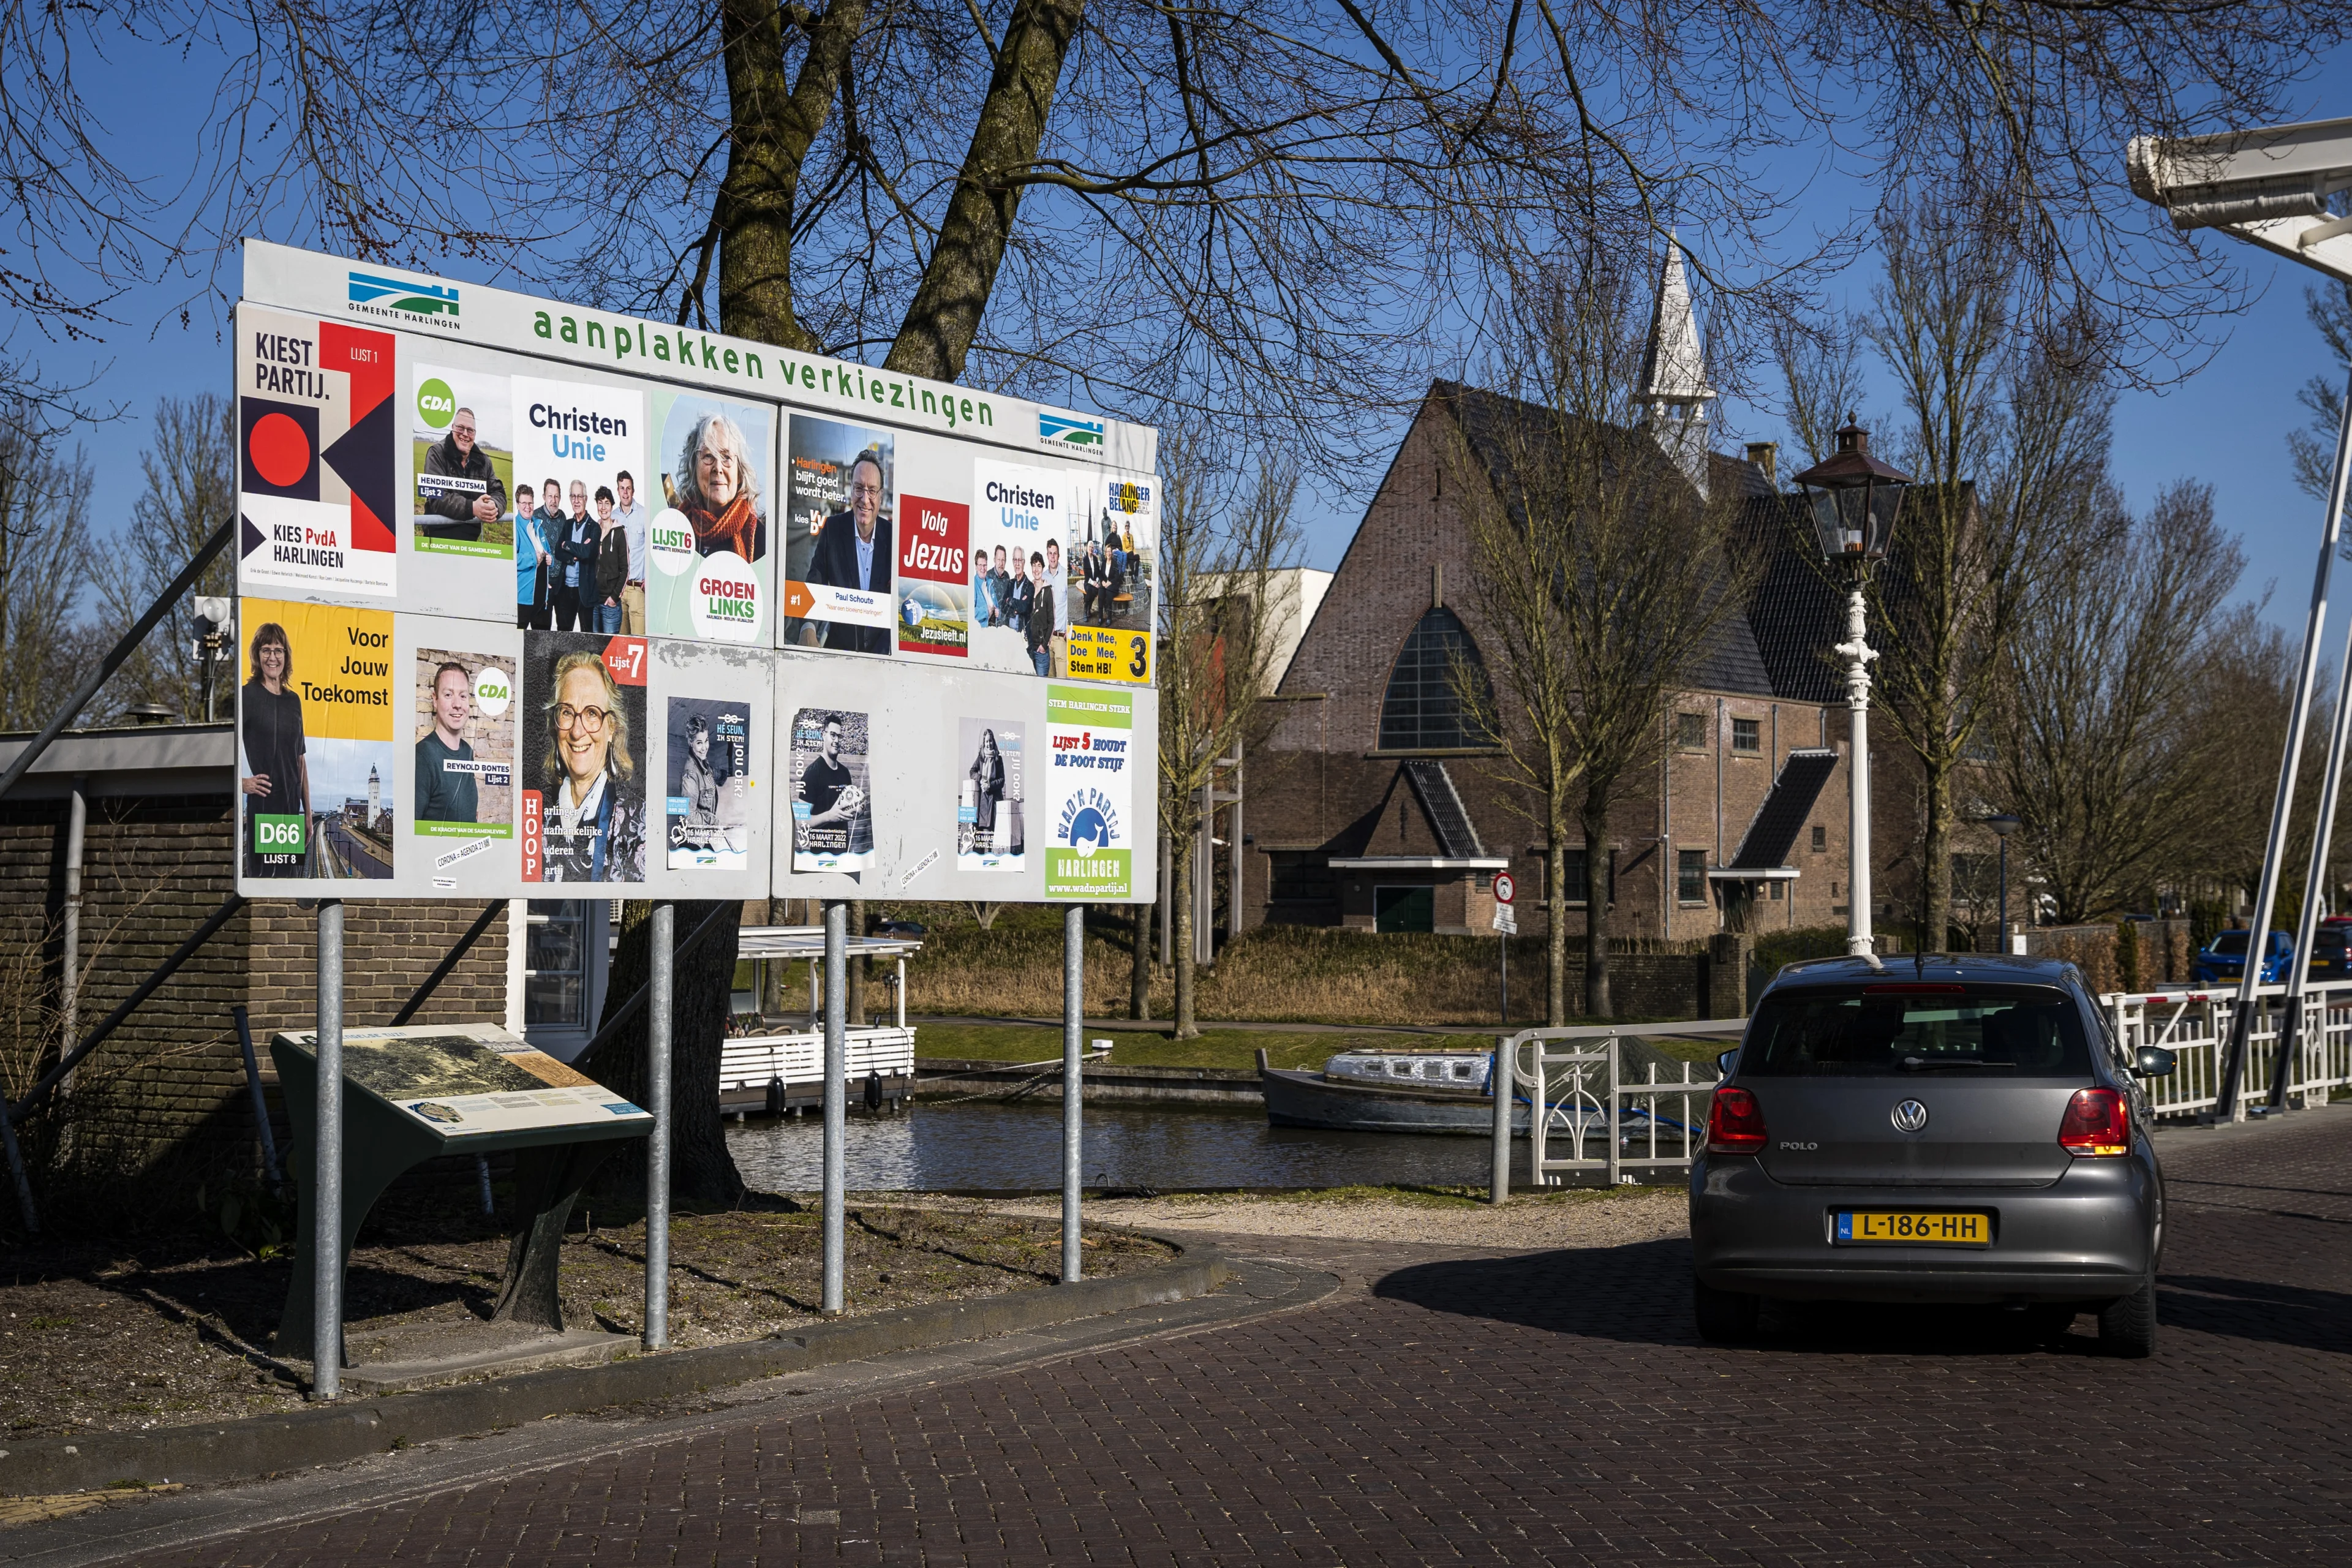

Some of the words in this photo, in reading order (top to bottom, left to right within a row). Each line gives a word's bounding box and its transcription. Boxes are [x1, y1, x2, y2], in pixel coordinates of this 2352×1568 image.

[349, 303, 399, 318] GEMEENTE
[404, 313, 460, 330] HARLINGEN
[256, 331, 313, 367] KIEST
[350, 347, 372, 363] LIJST
[374, 351, 378, 363] 1
[533, 311, 763, 379] aanplakken
[779, 359, 993, 428] verkiezingen
[256, 363, 330, 400] PARTIJ.
[421, 395, 452, 413] CDA
[529, 403, 627, 437] Christen
[552, 434, 606, 462] Unie
[1040, 437, 1069, 449] GEMEENTE
[1071, 444, 1103, 456] HARLINGEN
[796, 456, 837, 475] Harlingen
[421, 477, 453, 487] HENDRIK
[455, 481, 485, 491] SIJTSMA
[796, 470, 815, 484] blijft
[816, 477, 839, 488] goed
[420, 488, 436, 497] Lijst
[796, 486, 821, 498] wordt
[822, 488, 846, 502] beter.
[986, 481, 1054, 510] Christen
[1109, 482, 1150, 501] HARLINGER
[1109, 497, 1137, 513] BELANG
[794, 513, 809, 524] kies
[810, 509, 827, 536] VVD
[921, 510, 948, 537] Volg
[1001, 507, 1039, 531] Unie
[274, 524, 302, 544] KIES
[306, 528, 337, 547] PvdA
[274, 545, 344, 568] HARLINGEN
[904, 535, 964, 574] Jezus
[699, 578, 755, 600] GROEN
[835, 592, 848, 601] Paul
[850, 594, 874, 605] Schoute
[709, 597, 755, 618] LINKS
[790, 594, 801, 606] #1
[347, 627, 388, 648] Voor
[921, 626, 966, 643] Jezusleeft.nl
[1071, 630, 1093, 642] Denk
[1097, 632, 1117, 646] Mee,
[609, 656, 630, 671] Lijst
[628, 644, 644, 678] 7
[1071, 644, 1087, 656] Doe
[1097, 647, 1117, 661] Mee,
[1129, 636, 1147, 678] 3
[341, 656, 388, 677] Jouw
[1071, 660, 1093, 673] Stem
[1096, 662, 1112, 674] HB!
[301, 682, 388, 706] Toekomst
[478, 684, 507, 699] CDA
[1048, 699, 1067, 708] STEM
[1068, 700, 1108, 712] HARLINGEN
[1109, 704, 1131, 714] STERK
[717, 722, 725, 734] HÉ
[726, 724, 745, 736] SEUN,
[1053, 736, 1080, 752] LIJST
[1082, 732, 1090, 750] 5
[1093, 739, 1126, 752] HOUDT
[734, 742, 744, 766] JOU
[796, 747, 804, 777] OOK?
[1055, 754, 1068, 766] DE
[1069, 755, 1096, 768] POOT
[1098, 757, 1125, 772] STIJF
[447, 763, 480, 771] REYNOLD
[481, 764, 510, 773] BONTES
[488, 775, 502, 785] Lijst
[734, 769, 744, 798] OEK?
[796, 781, 806, 794] JIJ
[1058, 788, 1085, 839] WAD'N
[1090, 788, 1120, 839] PARTIJ
[260, 823, 300, 844] D66
[264, 854, 289, 864] LIJST
[291, 854, 296, 864] 8
[438, 853, 457, 867] CORONA
[461, 843, 478, 858] AGENDA
[478, 842, 484, 850] 21
[902, 870, 916, 884] CORONA
[918, 858, 930, 872] AGENDA
[1058, 859, 1120, 878] HARLINGEN
[1049, 883, 1128, 895] www.wadnpartij.nl
[1779, 1142, 1818, 1150] POLO
[1864, 1215, 1977, 1238] L-186-HH
